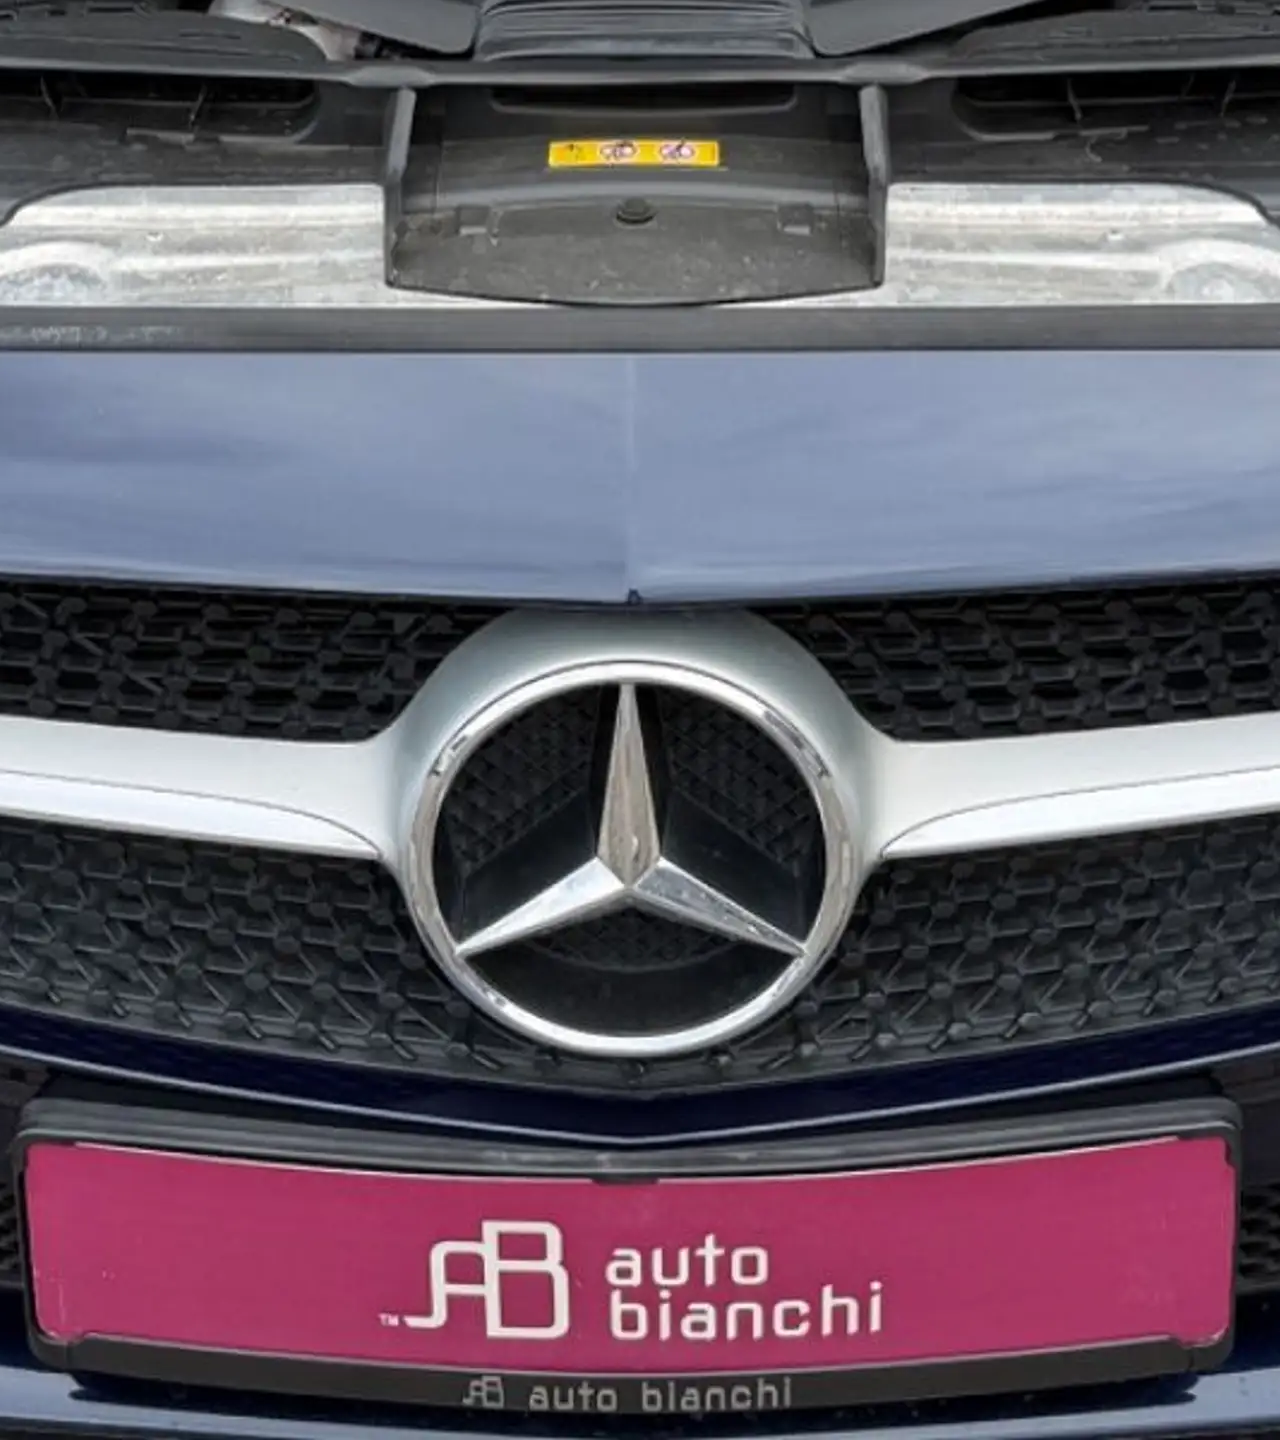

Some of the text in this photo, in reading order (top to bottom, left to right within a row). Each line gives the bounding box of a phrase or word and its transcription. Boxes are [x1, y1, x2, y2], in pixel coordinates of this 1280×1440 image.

[605, 1232, 770, 1288] auto
[609, 1280, 884, 1342] bianchi
[528, 1380, 619, 1412] auto
[640, 1376, 793, 1412] bianchi
